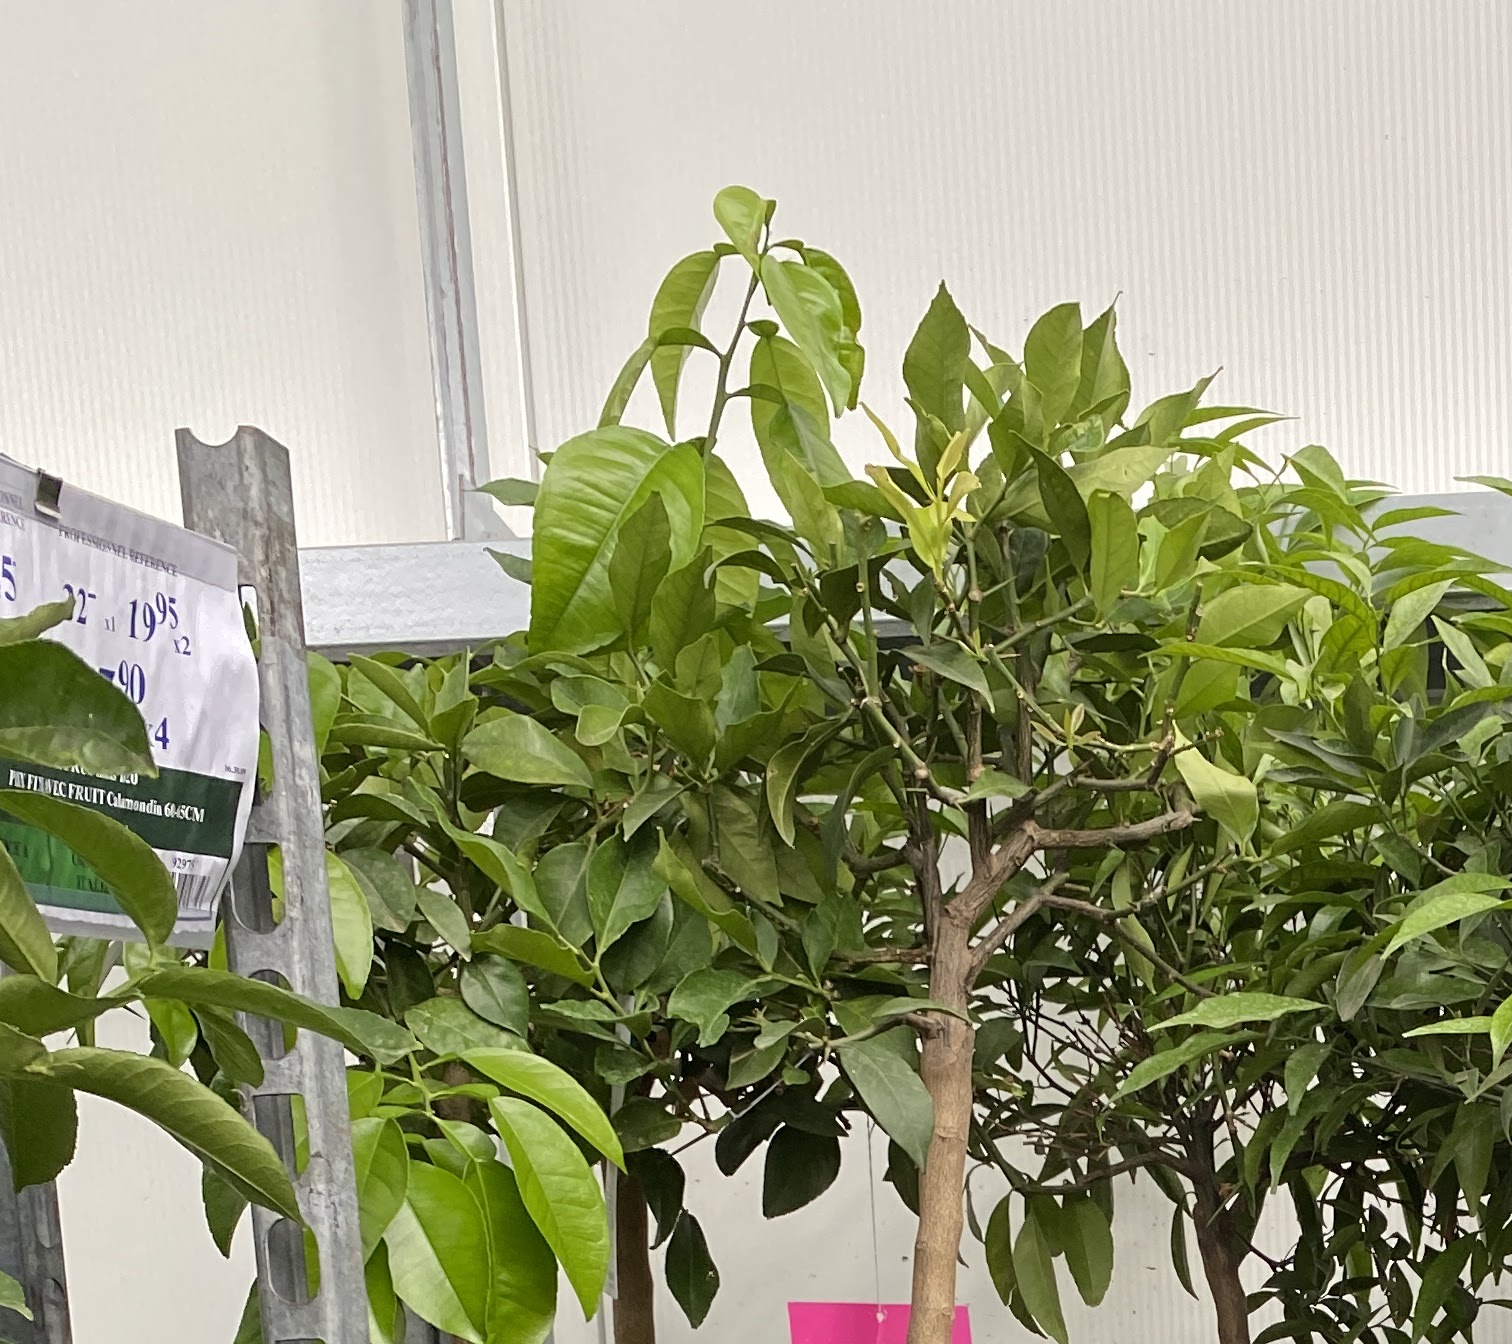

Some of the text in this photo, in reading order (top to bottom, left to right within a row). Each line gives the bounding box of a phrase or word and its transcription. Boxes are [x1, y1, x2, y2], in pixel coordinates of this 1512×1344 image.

[173, 635, 191, 656] x2
[68, 783, 106, 805] FRUIT
[106, 790, 163, 818] Calamondin
